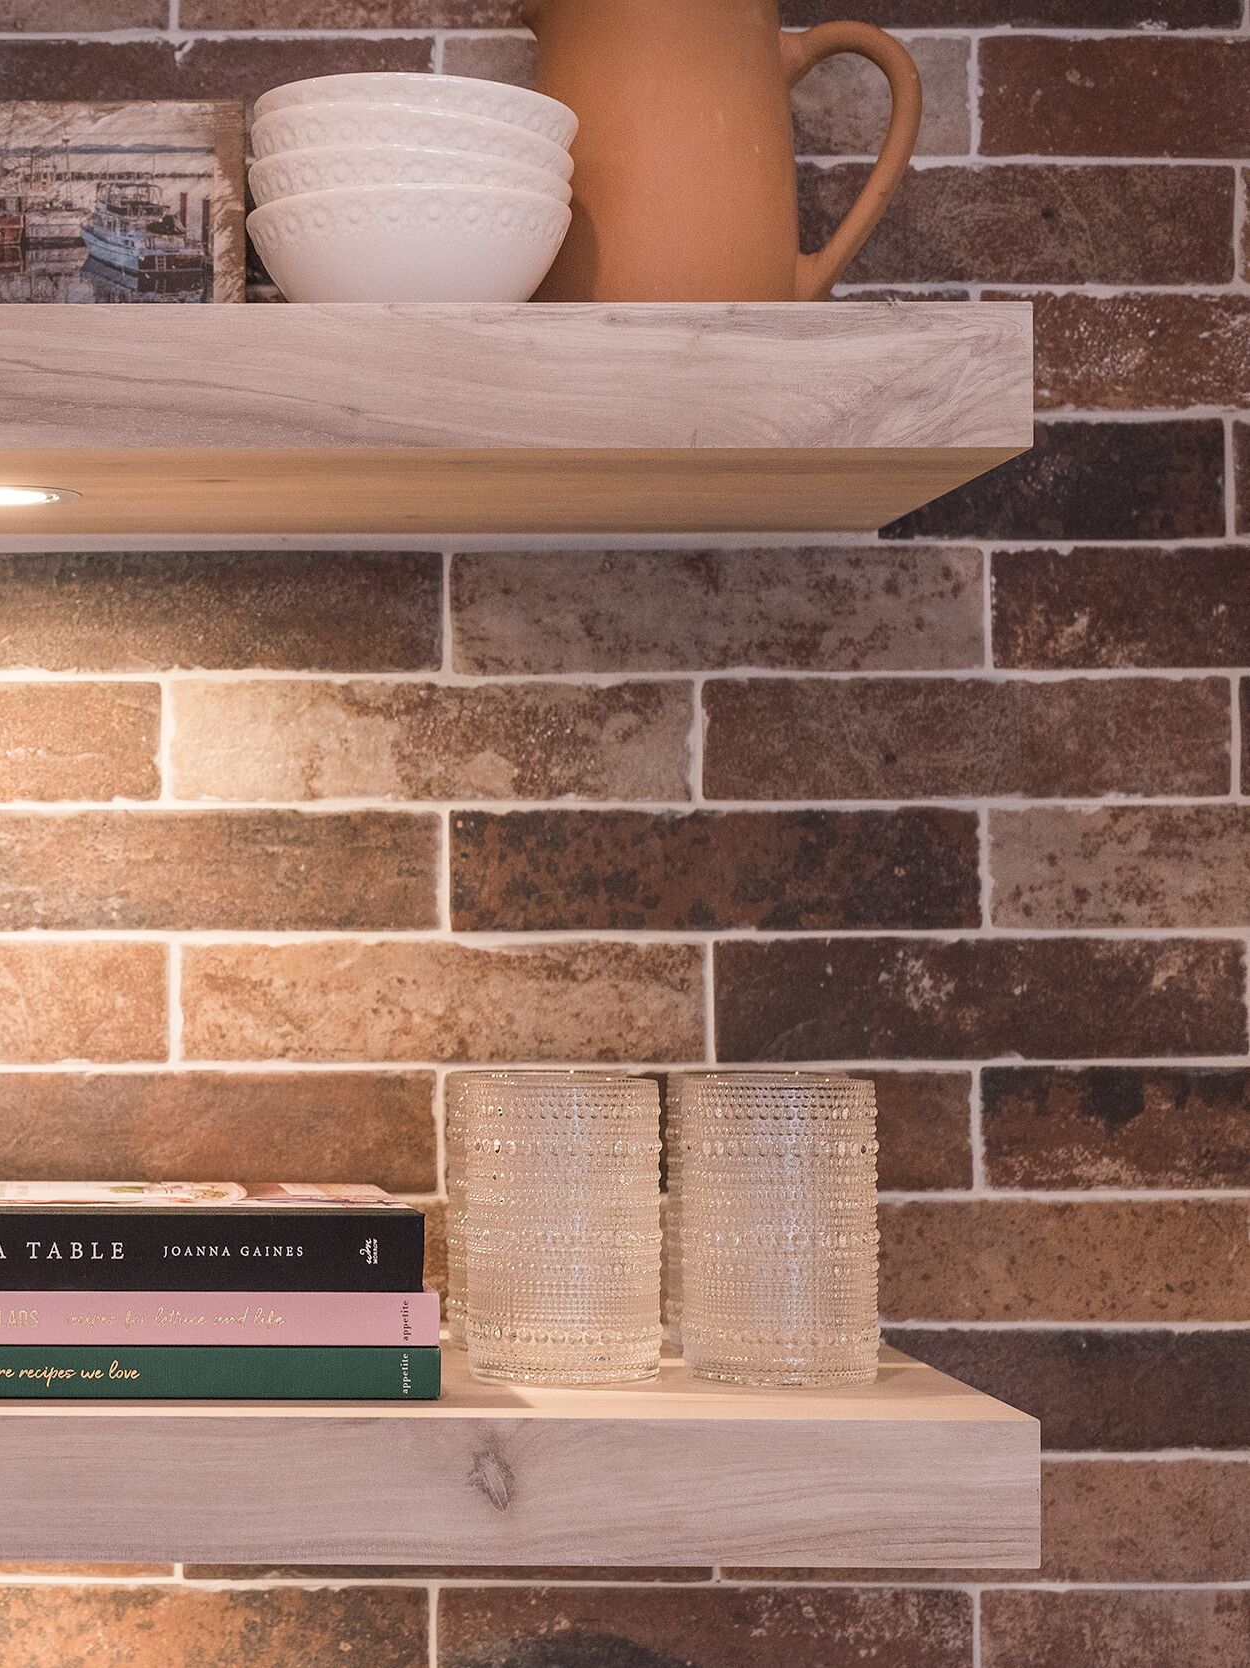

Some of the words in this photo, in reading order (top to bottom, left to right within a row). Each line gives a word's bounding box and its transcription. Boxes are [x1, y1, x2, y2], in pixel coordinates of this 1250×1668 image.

[26, 1241, 126, 1260] TABLE
[163, 1245, 232, 1258] JOANNA
[240, 1245, 304, 1258] GAINES
[124, 1309, 146, 1330] for
[154, 1307, 205, 1326] lettuce
[213, 1306, 250, 1328] and
[401, 1300, 412, 1341] appetite
[18, 1366, 77, 1388] recipes
[80, 1370, 104, 1379] we
[108, 1360, 140, 1380] love
[400, 1353, 412, 1395] appetite
